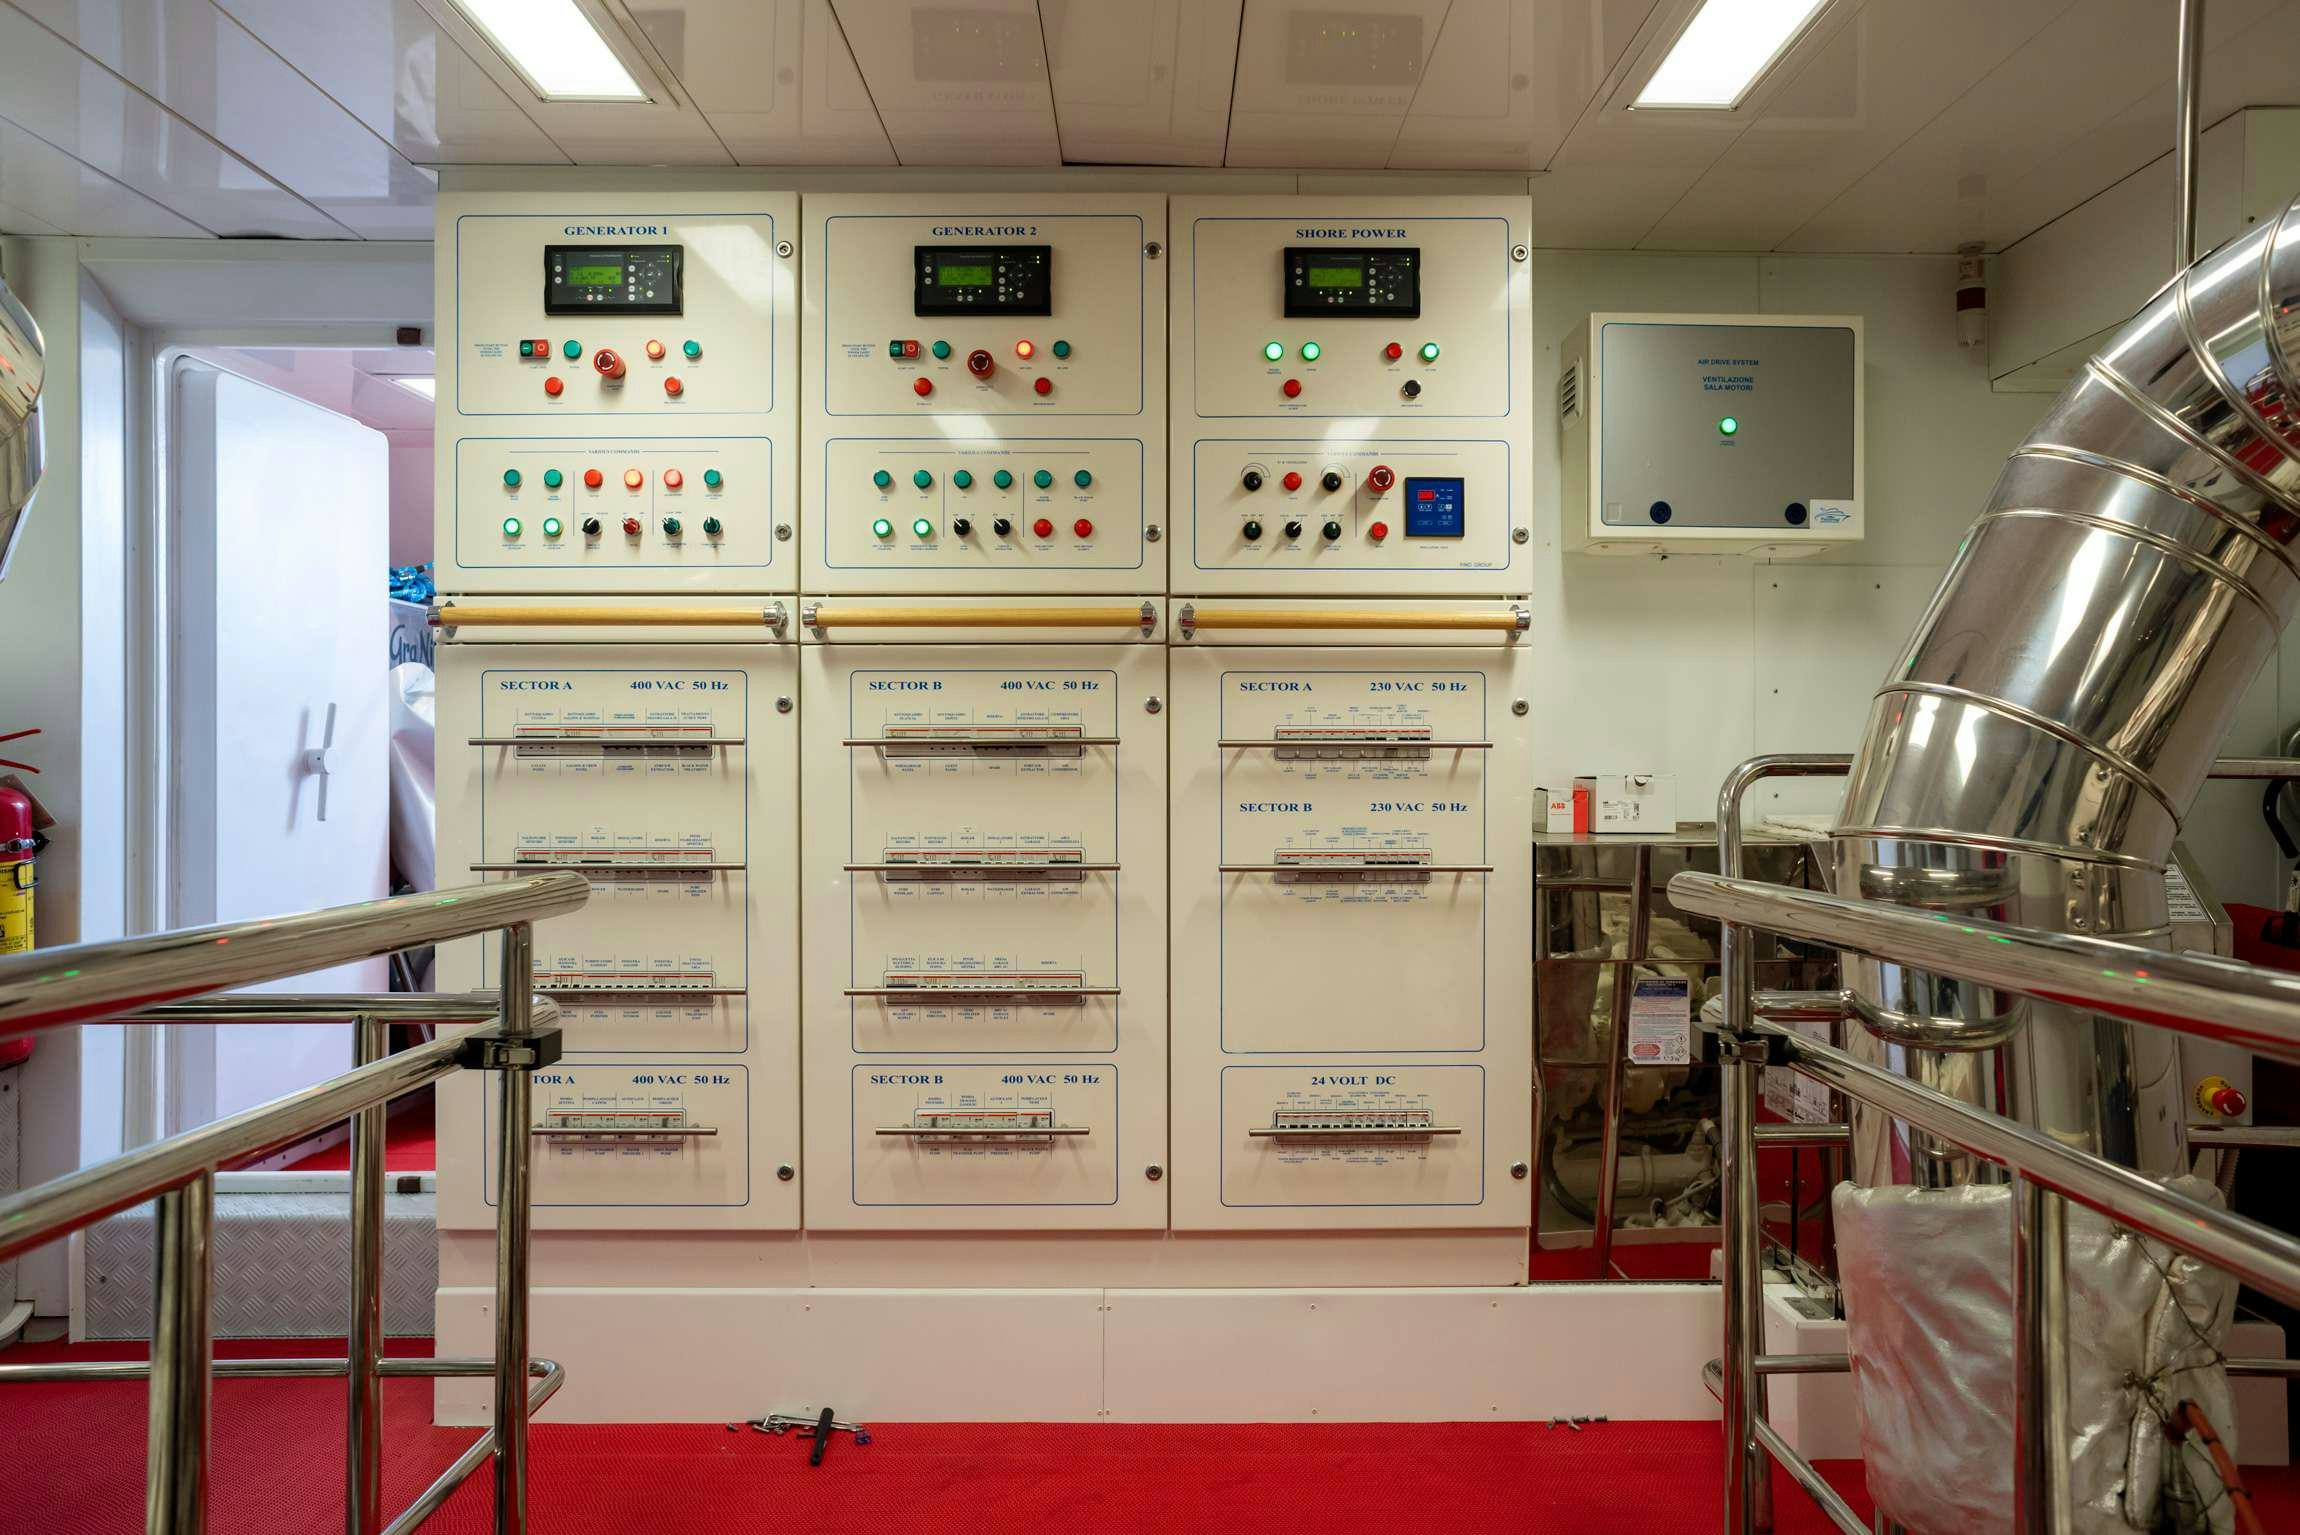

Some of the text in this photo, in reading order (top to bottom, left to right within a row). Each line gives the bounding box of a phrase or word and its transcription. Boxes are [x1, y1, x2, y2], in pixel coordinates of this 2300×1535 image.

[564, 226, 668, 236] GENERATOR 1
[932, 226, 1037, 236] GENERATOR 2
[1296, 228, 1407, 238] SHORE POWER
[501, 681, 573, 690] SECTOR A
[630, 680, 729, 690] 400 VAC 50 Hz
[869, 681, 943, 690] SECTOR B
[1001, 680, 1099, 690] 400 VAC 50 Hz
[1240, 682, 1313, 691] SECTOR A
[1370, 682, 1468, 691] 230 VAC 50 Hz
[1240, 803, 1313, 812] SECTOR B
[1370, 803, 1468, 812] 230 VAC 50 Hz
[533, 1075, 575, 1085] TOR A
[632, 1075, 730, 1085] 400 VAC 50 Hz
[870, 1075, 944, 1085] SECTOR B
[1001, 1074, 1100, 1084] 400 VAC 50 Hz
[1311, 1076, 1396, 1086] 24 VOLT DC
